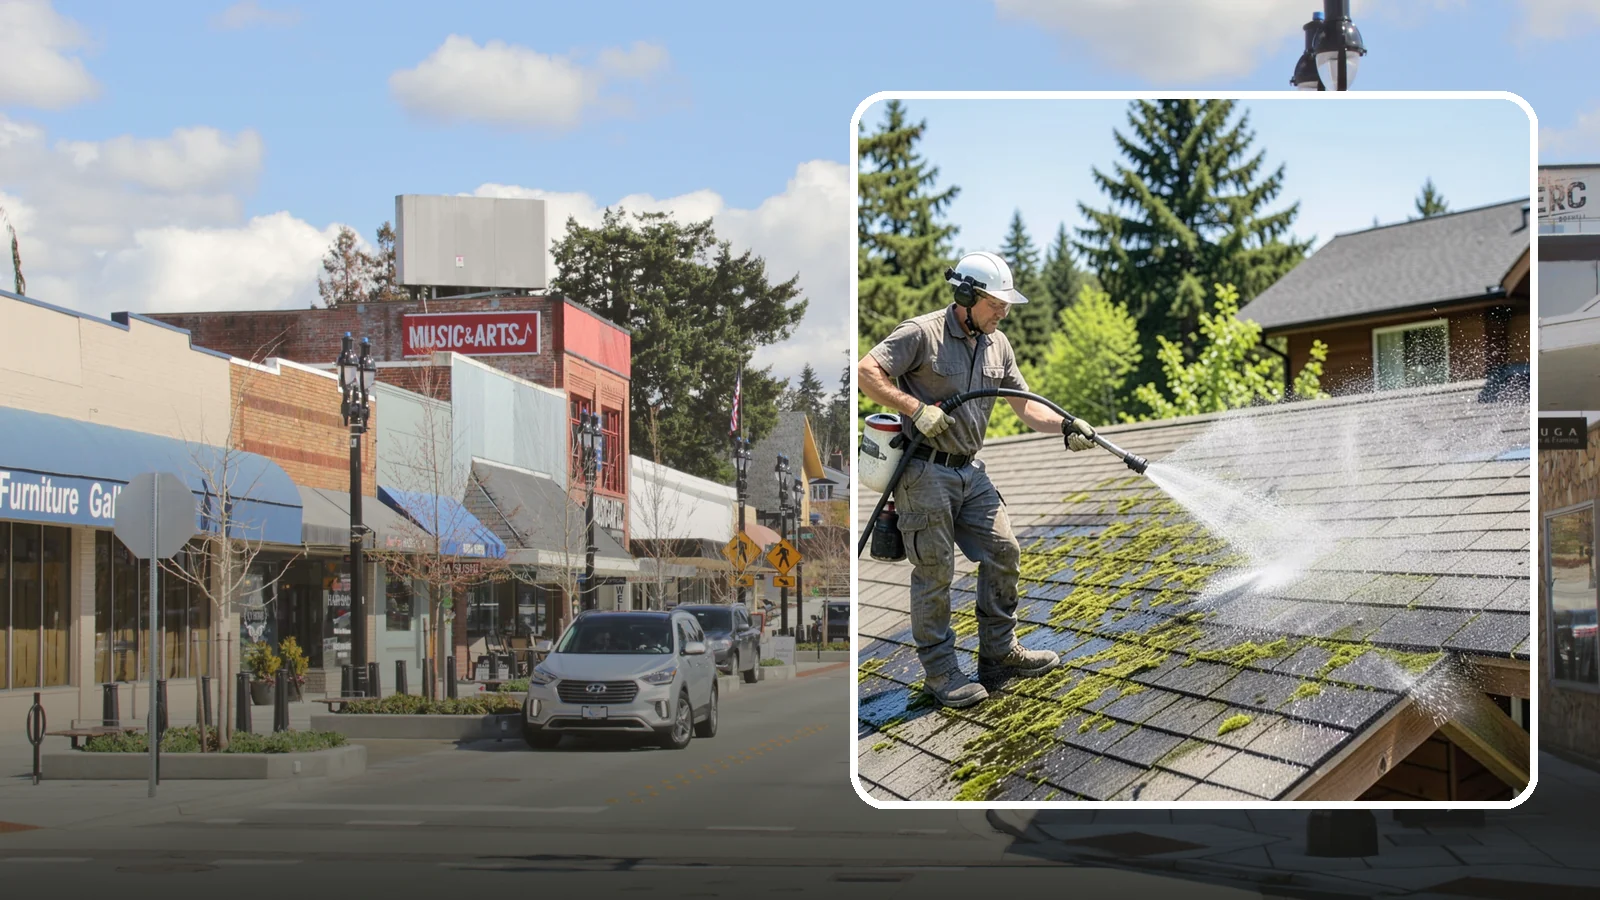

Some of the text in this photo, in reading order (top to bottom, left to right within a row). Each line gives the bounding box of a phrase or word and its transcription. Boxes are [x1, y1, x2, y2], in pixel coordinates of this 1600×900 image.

[0, 471, 79, 515] Furniture
[453, 563, 479, 574] SUSHI
[327, 594, 340, 606] HAIR
